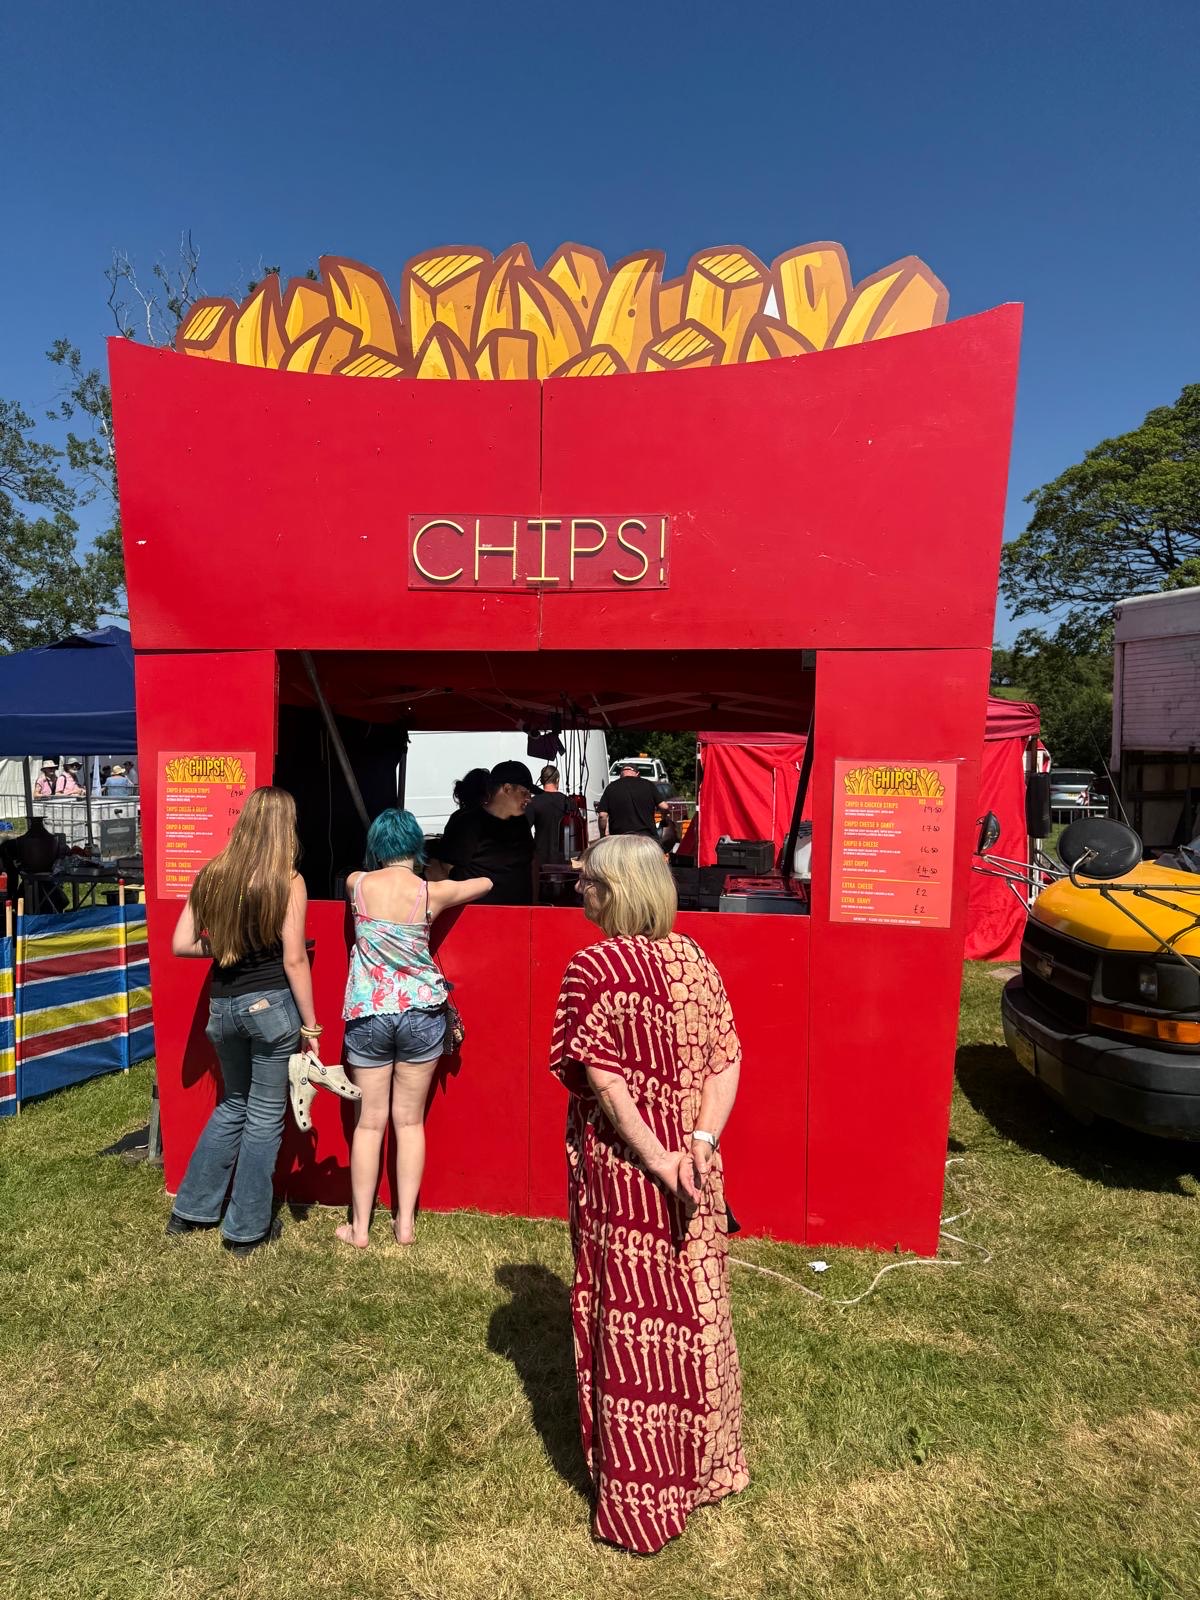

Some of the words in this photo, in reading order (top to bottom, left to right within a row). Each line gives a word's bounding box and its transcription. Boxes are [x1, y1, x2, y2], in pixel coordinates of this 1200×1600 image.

[413, 519, 665, 581] CHIPS!
[189, 758, 224, 777] CHIPS!
[873, 770, 917, 790] CHIPS!
[864, 801, 882, 809] CHICKEN
[916, 888, 927, 897] £2
[914, 904, 925, 914] £2
